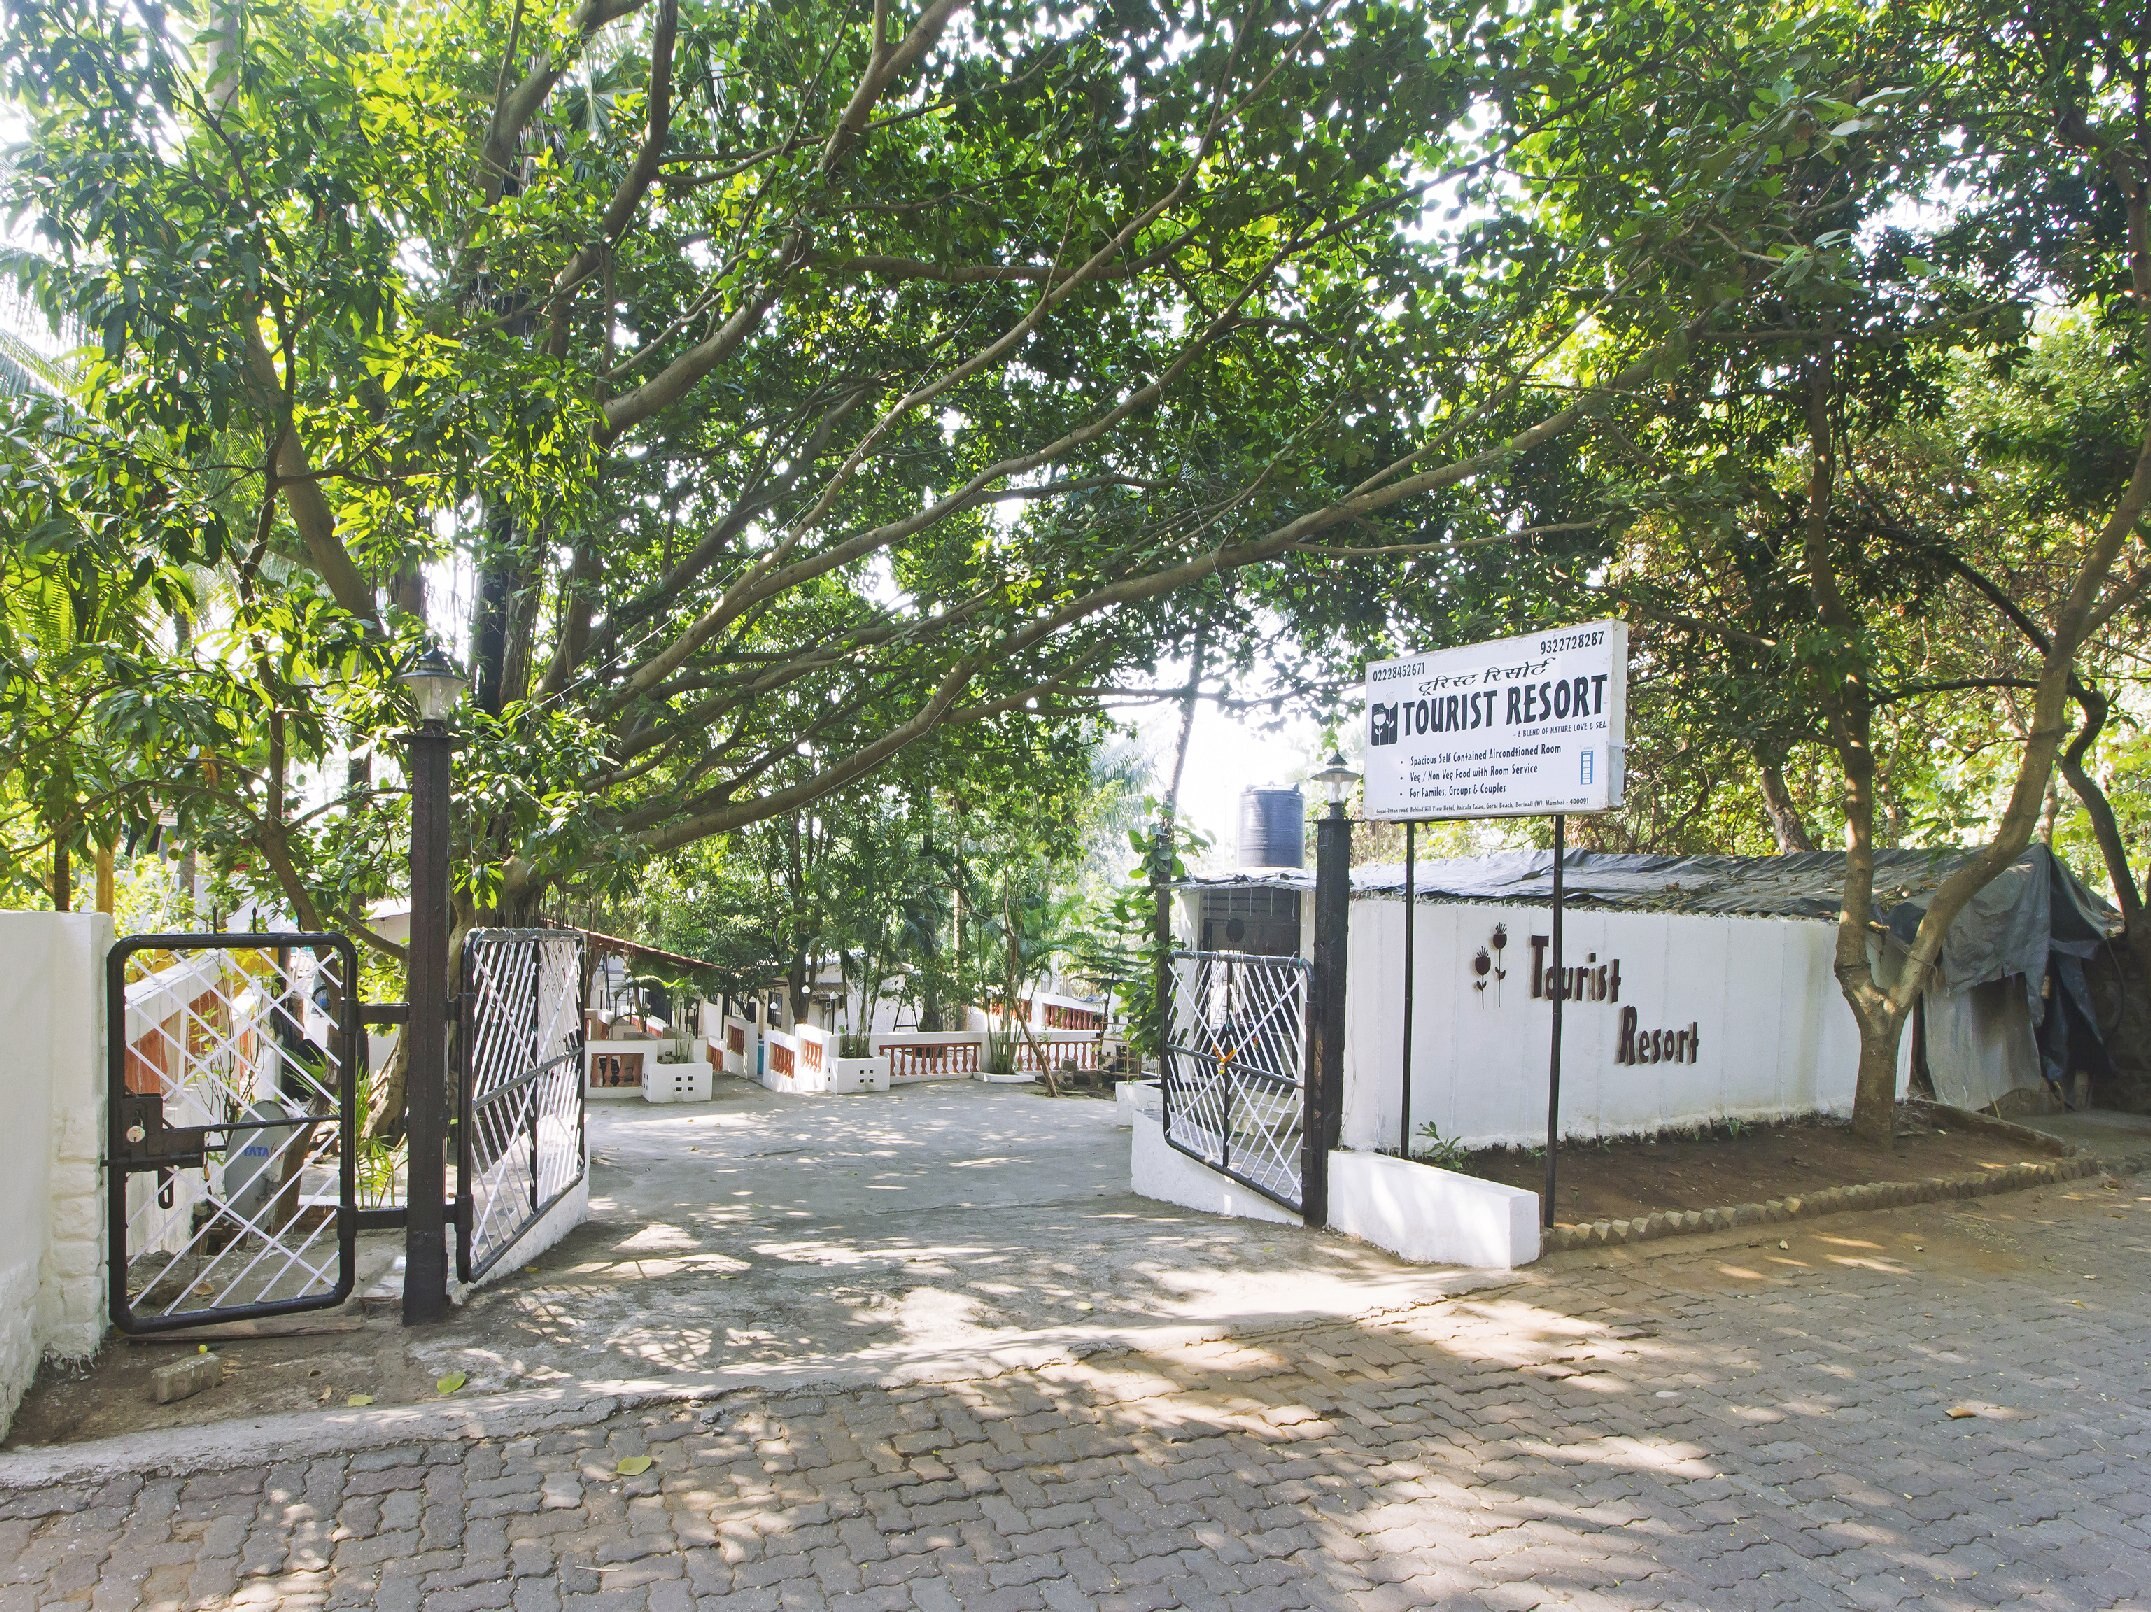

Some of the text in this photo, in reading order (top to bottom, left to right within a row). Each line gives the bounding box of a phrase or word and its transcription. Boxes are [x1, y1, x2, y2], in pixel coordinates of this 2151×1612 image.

[1540, 631, 1605, 656] 9322728287
[1372, 662, 1425, 682] 02228452671
[1418, 657, 1556, 696] टूरिस्ट रिसोर्ट
[1402, 674, 1608, 736] TOURIST RESORT
[1542, 726, 1548, 735] OF
[1550, 724, 1571, 734] NATURE
[1573, 723, 1587, 732] LOVE
[1596, 720, 1607, 729] SEA
[1410, 755, 1437, 767] Spacious
[1453, 750, 1487, 762] Contained
[1541, 743, 1561, 755] Room
[1410, 771, 1421, 783] Veg
[1428, 770, 1440, 781] Non
[1443, 769, 1453, 781] Veg
[1455, 768, 1471, 779] Food
[1473, 766, 1487, 777] with
[1490, 765, 1509, 776] Room
[1512, 763, 1538, 775] Service
[1409, 788, 1420, 798] For
[1449, 785, 1471, 797] Groups
[1473, 784, 1478, 795] &
[1480, 782, 1507, 795] Couples
[1618, 1005, 1699, 1065] Resort
